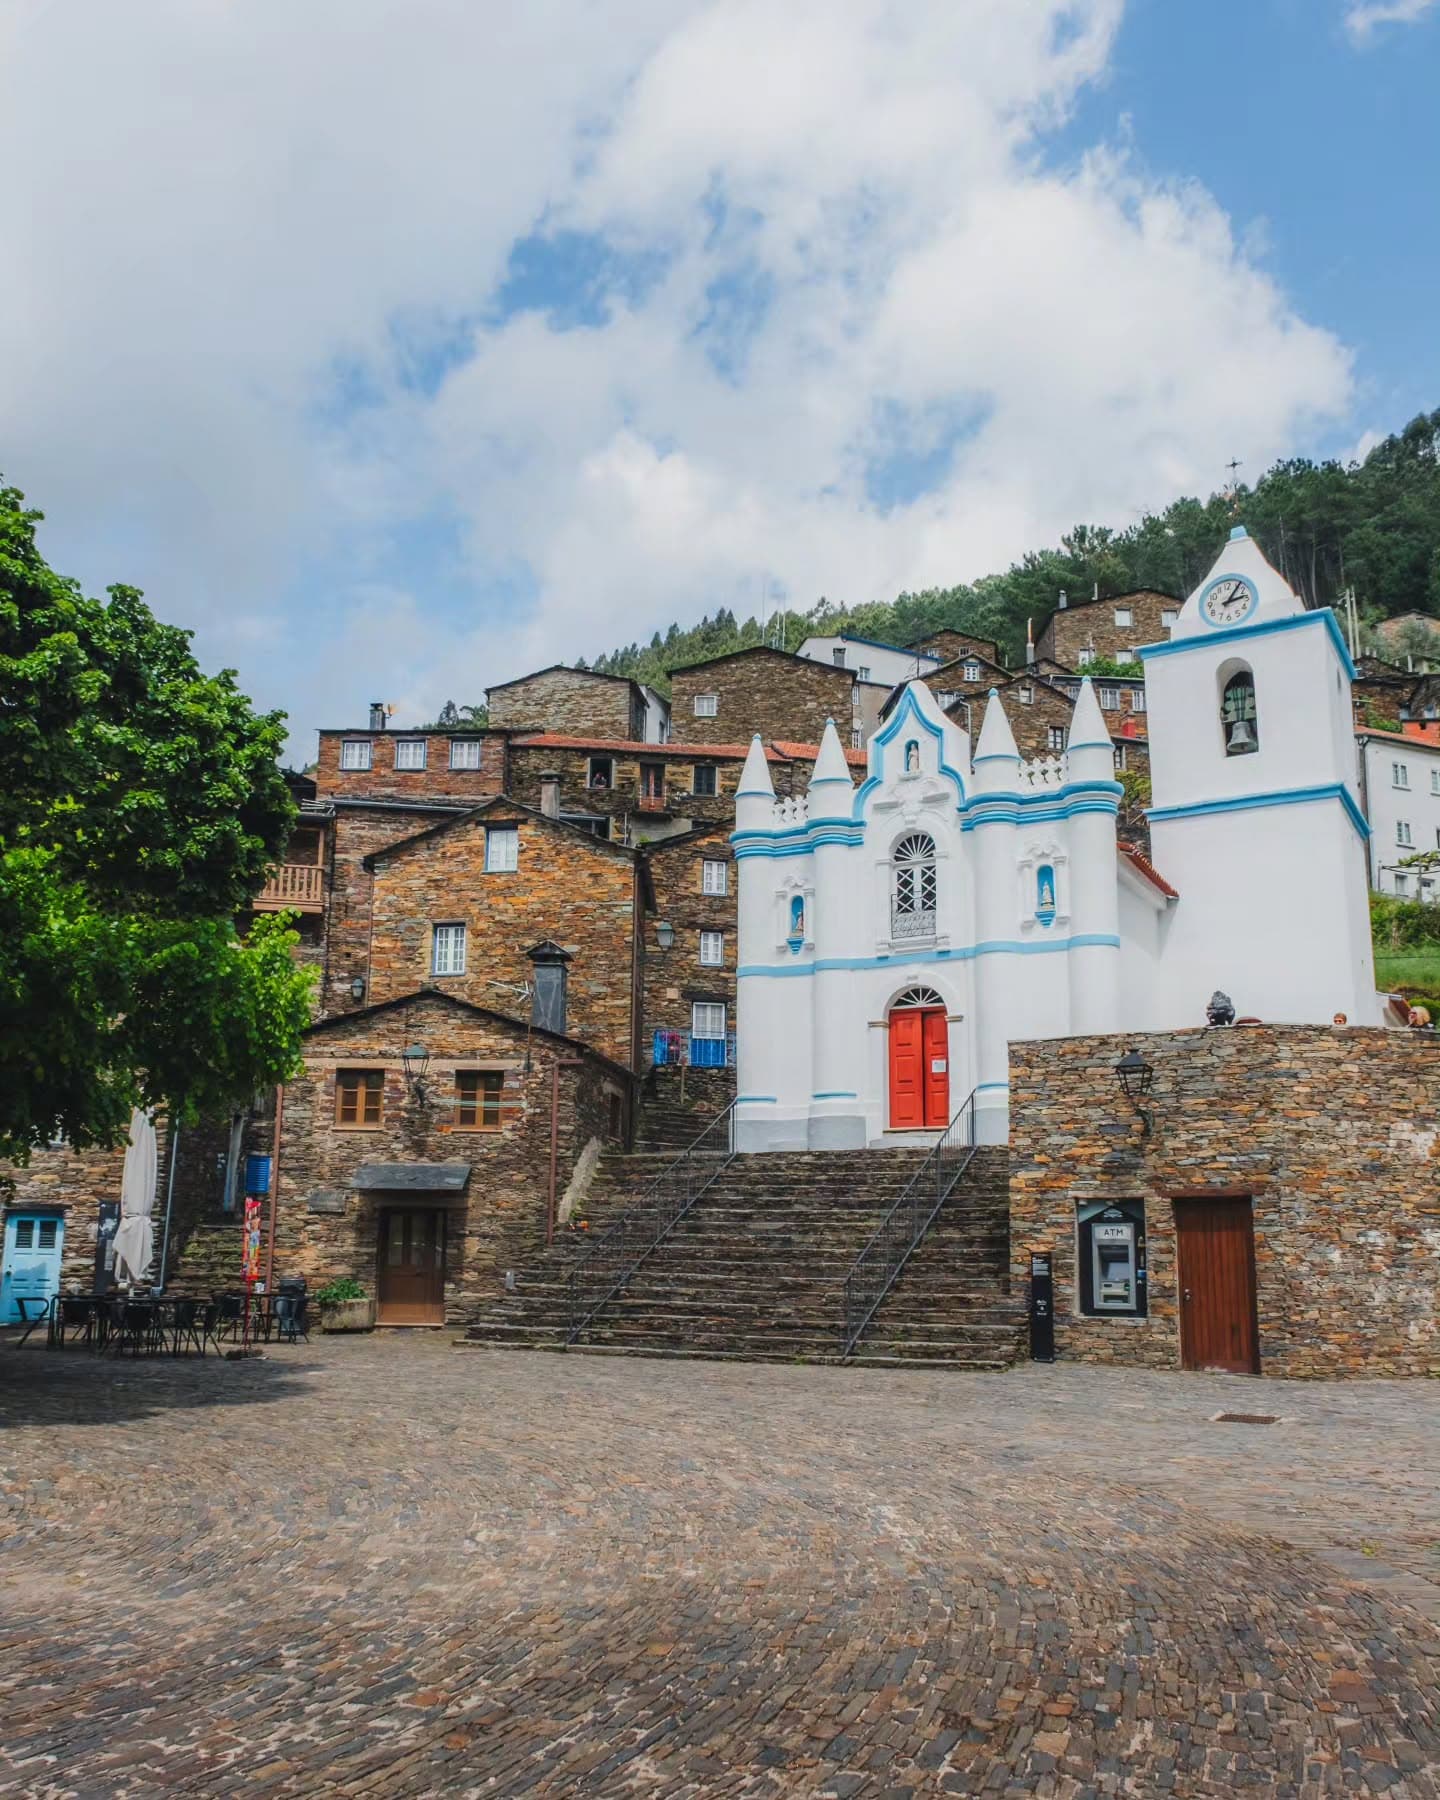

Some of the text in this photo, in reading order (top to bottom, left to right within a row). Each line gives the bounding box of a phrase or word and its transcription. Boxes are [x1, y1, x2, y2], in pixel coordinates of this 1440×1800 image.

[1224, 582, 1231, 591] 12
[1240, 586, 1246, 594] 2
[1210, 592, 1217, 601] 10
[1207, 601, 1213, 610] 9
[1218, 613, 1223, 621] 7
[1235, 610, 1241, 618] 5
[1104, 1228, 1124, 1237] ATM
